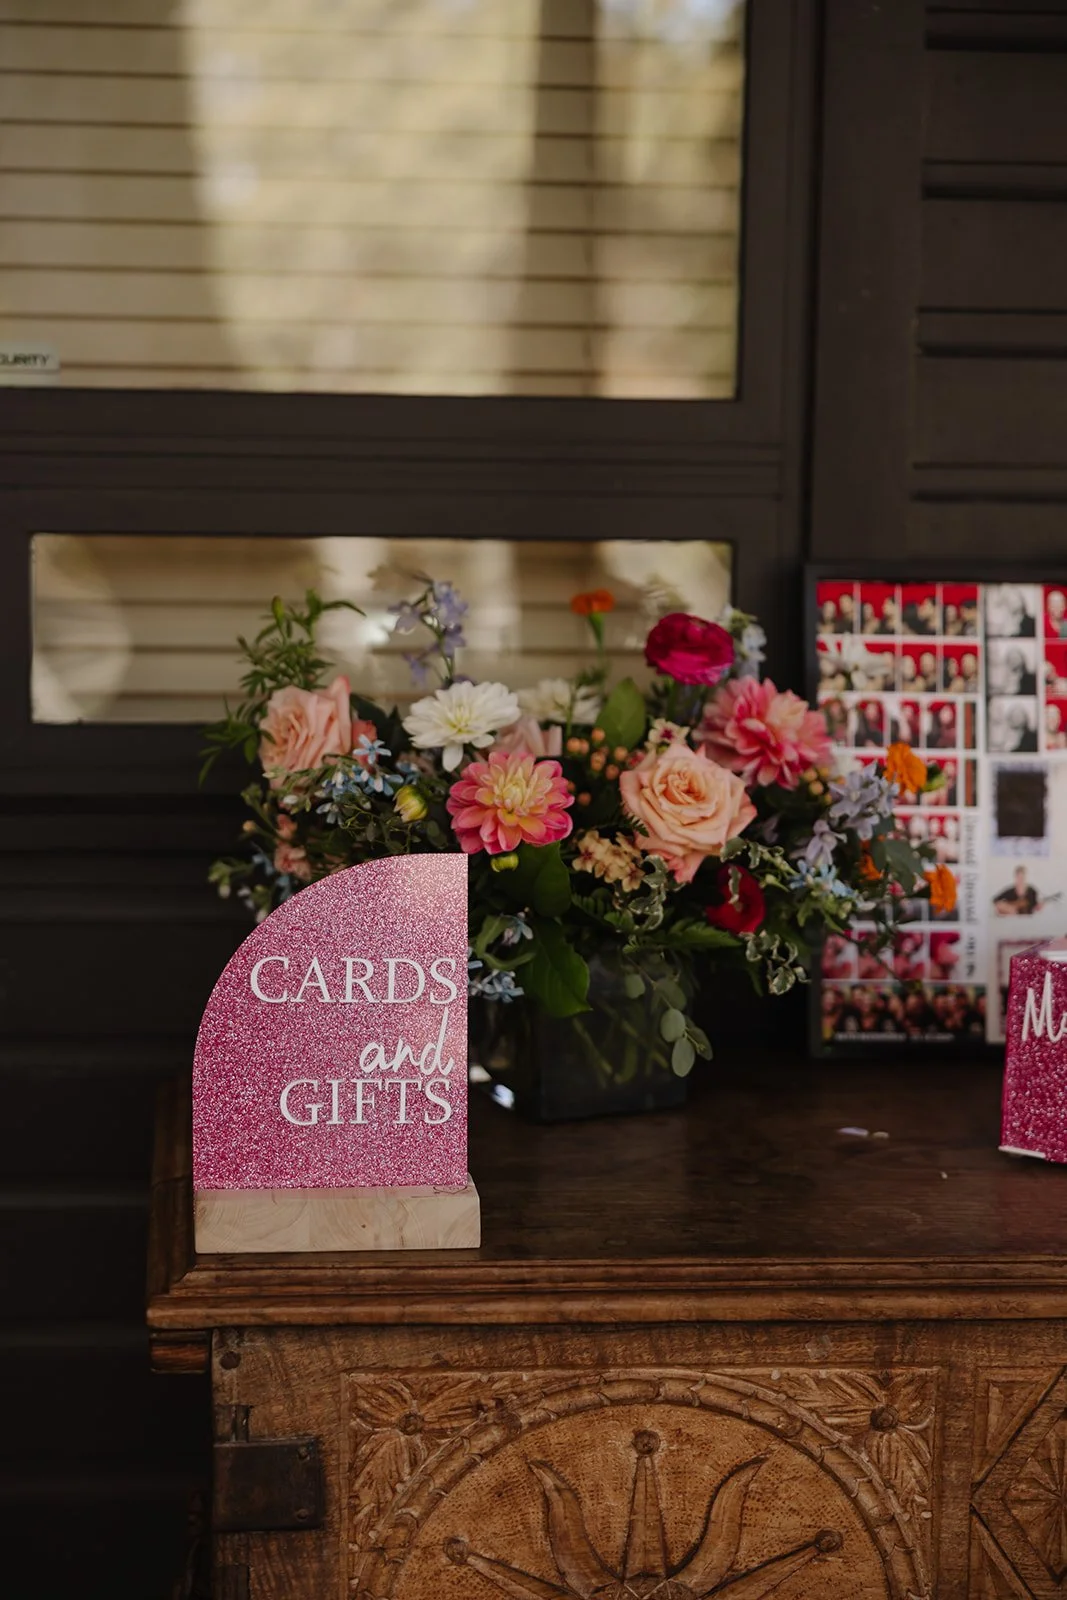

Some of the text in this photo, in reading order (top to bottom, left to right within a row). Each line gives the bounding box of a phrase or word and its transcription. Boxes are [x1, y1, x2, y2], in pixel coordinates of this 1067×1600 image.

[250, 956, 458, 1004] CARDS
[359, 1006, 454, 1076] and
[279, 1078, 452, 1126] GIFTS
